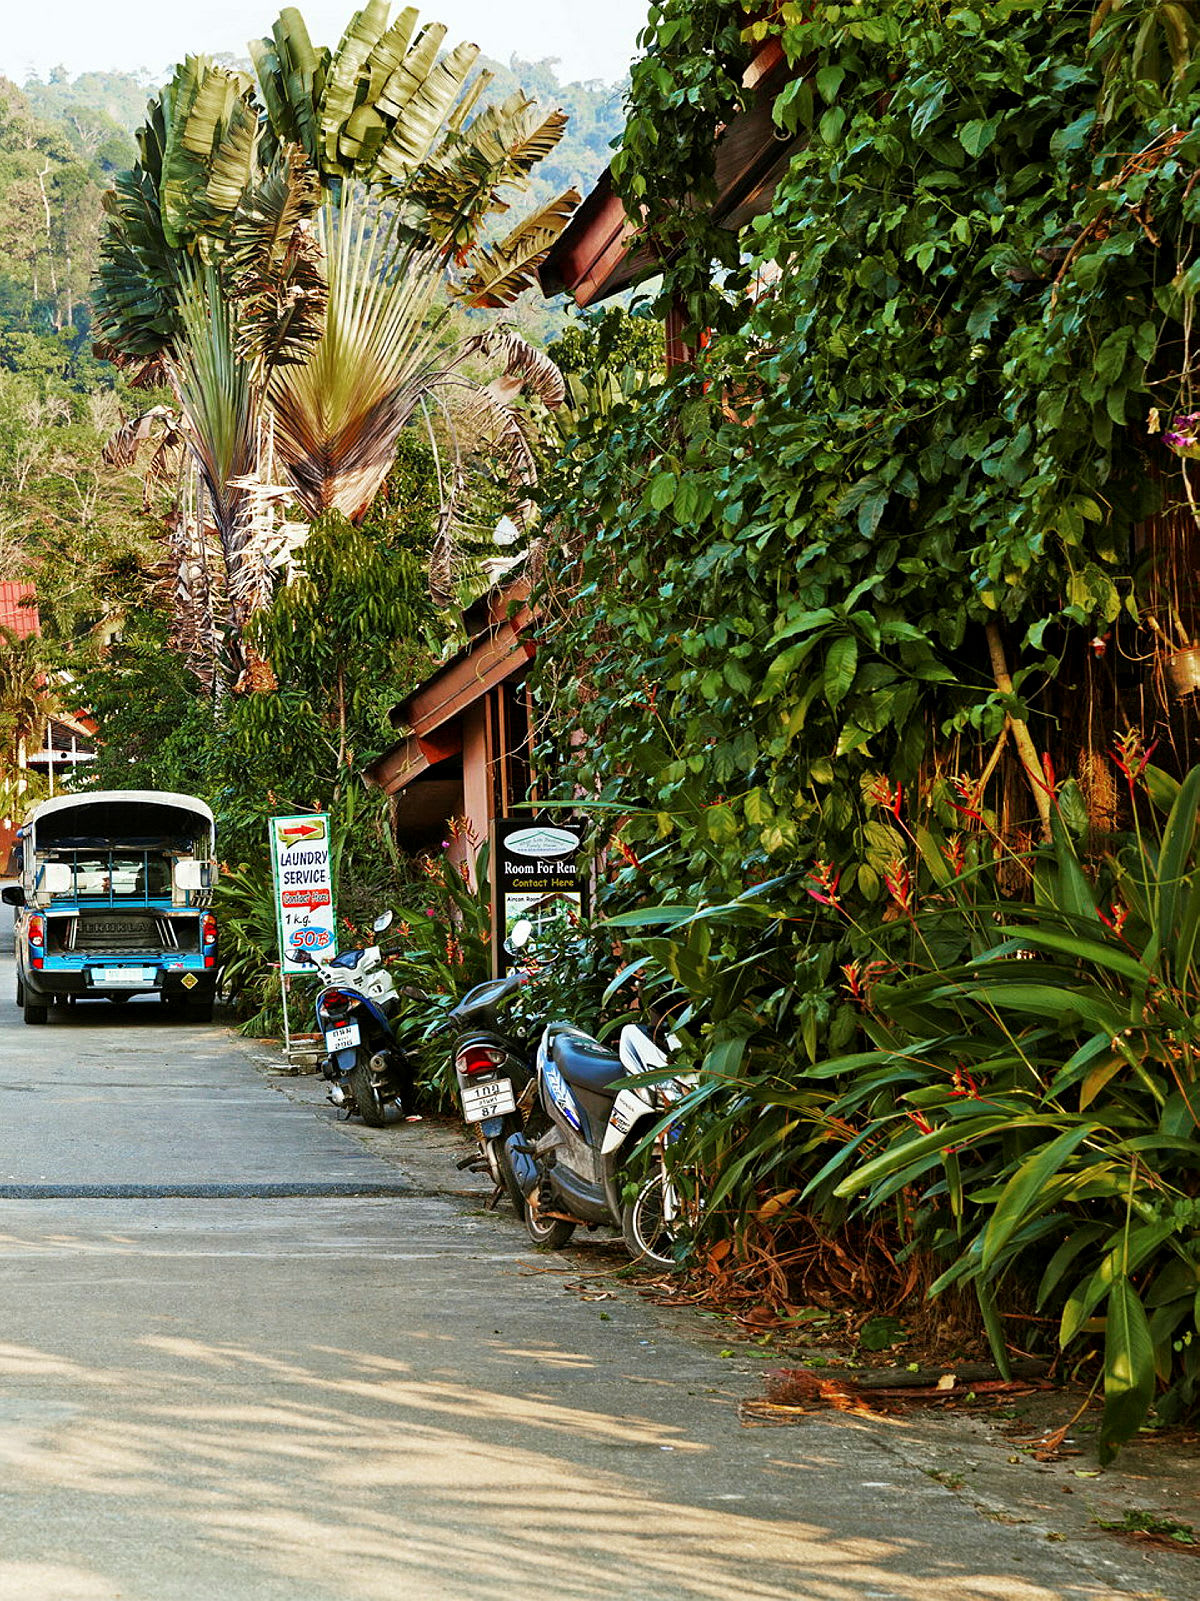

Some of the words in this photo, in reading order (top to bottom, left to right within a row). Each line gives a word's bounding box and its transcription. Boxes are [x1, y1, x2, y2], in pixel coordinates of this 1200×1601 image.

[280, 850, 328, 867] LAUNDRY
[504, 861, 534, 874] Room
[536, 861, 555, 874] For
[556, 861, 579, 874] Ren
[283, 869, 326, 885] SERVICE
[512, 879, 548, 888] Contact
[551, 878, 575, 887] Here
[283, 892, 311, 904] Contact
[285, 914, 291, 925] 1
[481, 1105, 498, 1117] 87
